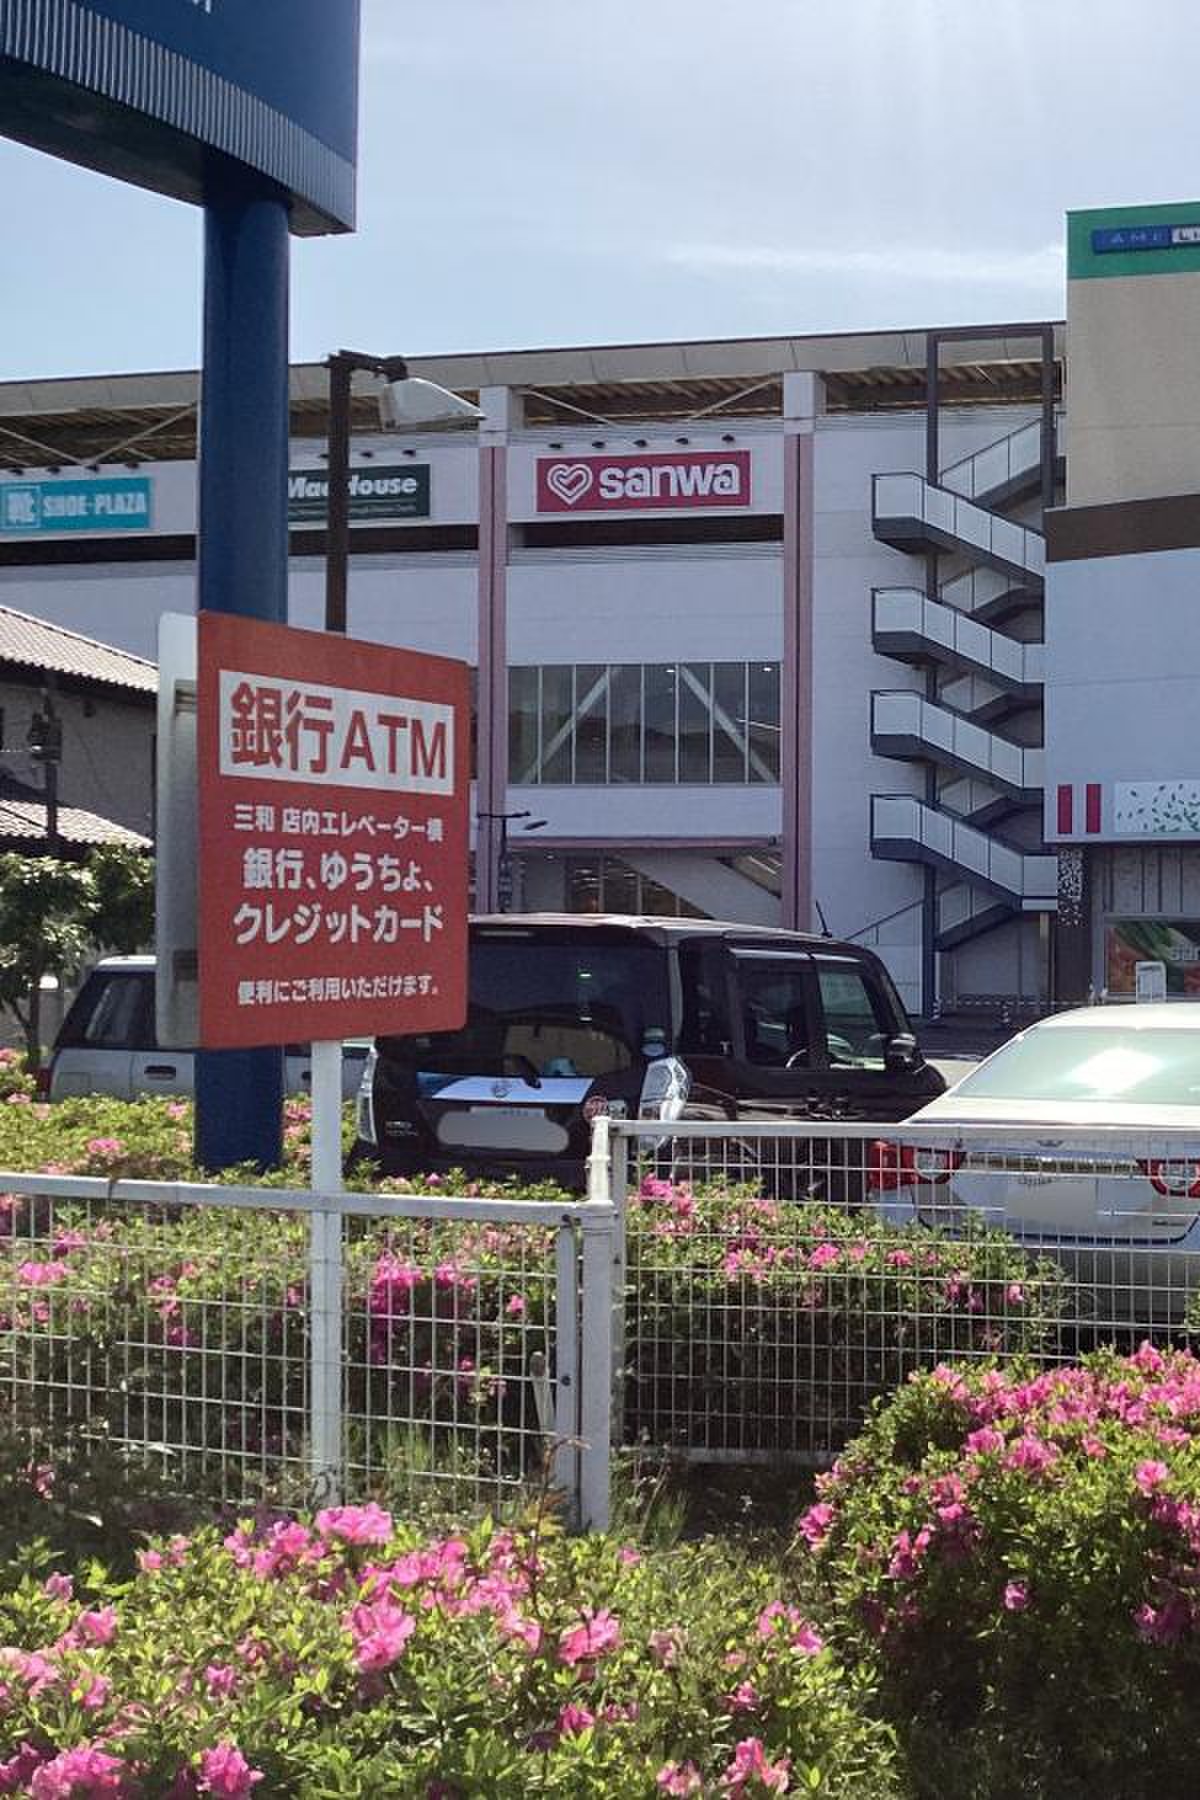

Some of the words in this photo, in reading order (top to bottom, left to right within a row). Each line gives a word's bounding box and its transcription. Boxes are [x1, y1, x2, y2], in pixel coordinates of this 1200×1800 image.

[600, 463, 741, 499] sanwa
[234, 804, 275, 832] 三和
[243, 847, 433, 892] 銀行、ゆうちょ、
[233, 902, 444, 944] クレジットカード
[237, 972, 439, 1006] 便利にご利用いただけます。
